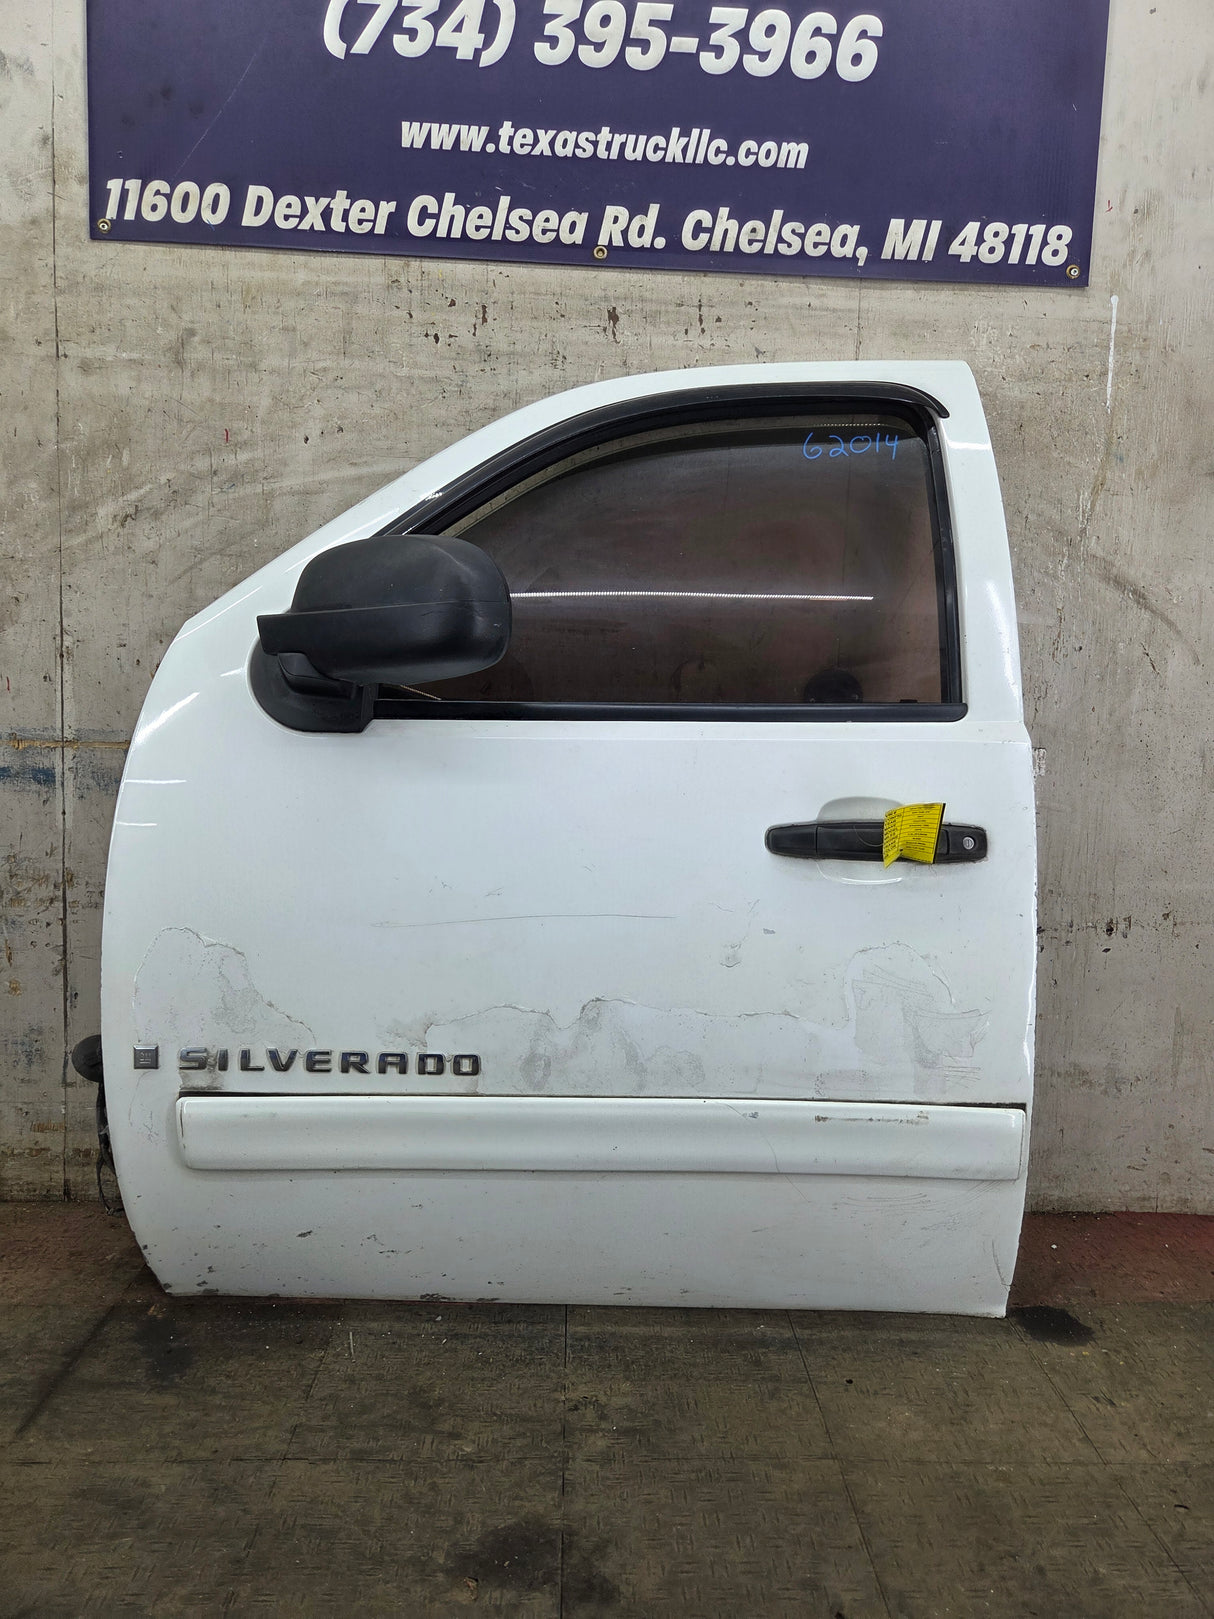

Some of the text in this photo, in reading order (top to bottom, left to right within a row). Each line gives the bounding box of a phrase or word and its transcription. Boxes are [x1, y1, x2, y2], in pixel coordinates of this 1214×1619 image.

[323, 0, 883, 82] (734) 395-3966
[401, 121, 808, 169] www.texastruckllc.com
[105, 179, 1072, 267] 11600 Dexter Chelsea Rd. Chelsea, MI 48118
[803, 432, 899, 460] 62014
[179, 1046, 482, 1077] SILVERADO
